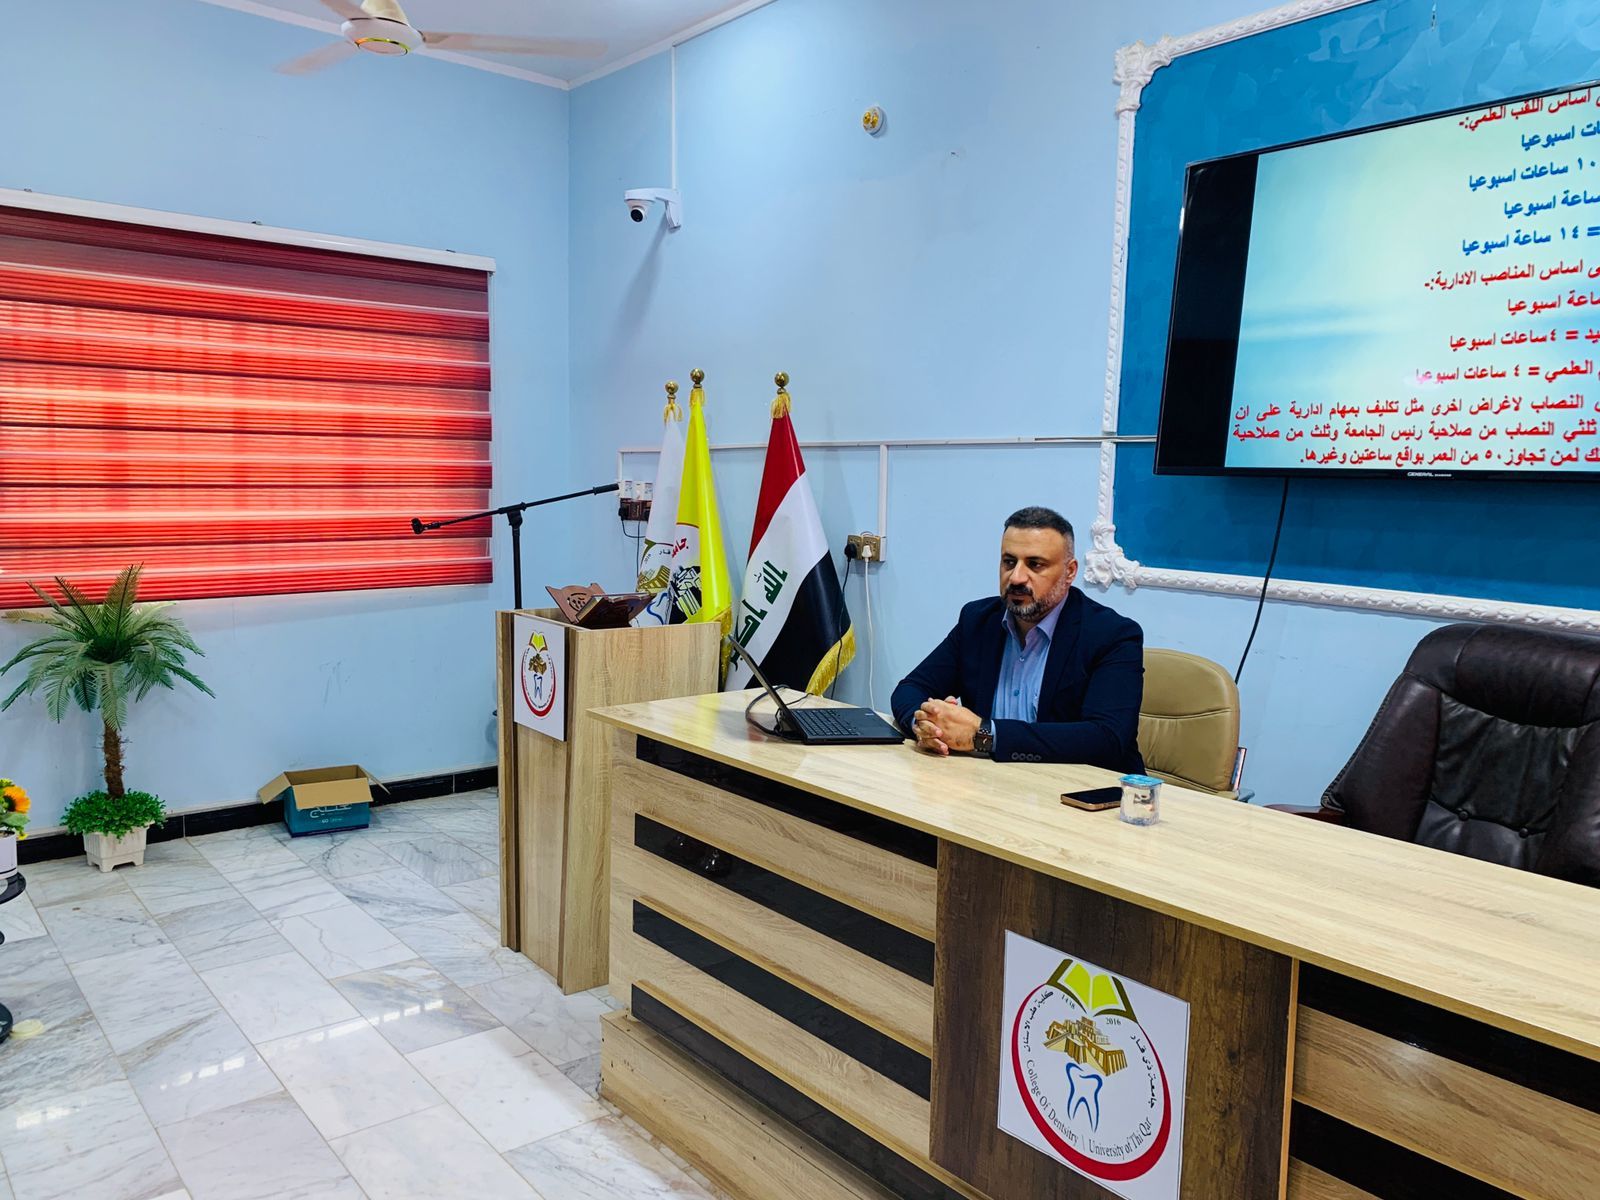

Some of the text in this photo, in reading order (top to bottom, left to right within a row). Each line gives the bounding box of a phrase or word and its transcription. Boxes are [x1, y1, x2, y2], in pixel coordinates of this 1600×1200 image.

[1511, 97, 1543, 119] اللقب
[1548, 88, 1590, 113] اساس
[1521, 125, 1575, 151] اسبوعيا
[1469, 168, 1516, 192] اسبوعيا
[1520, 162, 1568, 180] ساعات
[1504, 195, 1556, 219] اسبوعيا
[1462, 234, 1509, 256] اسبوعيا
[1513, 229, 1551, 245] ساعة
[1481, 263, 1534, 286] المناصب
[1540, 259, 1583, 280] اساس
[1507, 294, 1561, 315] اسبوعيا
[1450, 333, 1495, 351] اسبوعيا
[1416, 367, 1460, 385] اسبوعيا
[1464, 365, 1507, 379] ساعات
[1545, 360, 1593, 383] العلمي
[1235, 405, 1249, 420] ان
[1256, 403, 1281, 421] على
[1289, 401, 1323, 419] ادارية
[1329, 402, 1360, 420] بمهام
[1366, 399, 1399, 417] تكليف
[1404, 397, 1425, 415] مثل
[1431, 398, 1462, 415] اخرى
[1469, 395, 1522, 415] لاغراض
[1531, 394, 1584, 414] النصاب
[1233, 424, 1280, 442] صلاحية
[1286, 428, 1303, 441] من
[1310, 423, 1338, 441] وثلث
[1344, 422, 1385, 441] الجامعة
[1428, 421, 1472, 441] صلاحية
[1479, 425, 1497, 440] من
[1505, 420, 1555, 439] النصاب
[1563, 418, 1597, 442] ثلثي
[1350, 448, 1392, 464] ساعتين
[1395, 445, 1425, 467] بواقع
[1428, 447, 1456, 464] العمر
[1460, 451, 1478, 465] من
[1551, 448, 1579, 466] لمن
[1026, 1059, 1041, 1097] College
[1040, 1096, 1051, 1110] Of
[1089, 1139, 1125, 1160] University
[1130, 1131, 1144, 1149] Thi
[1139, 1116, 1152, 1137] Qar
